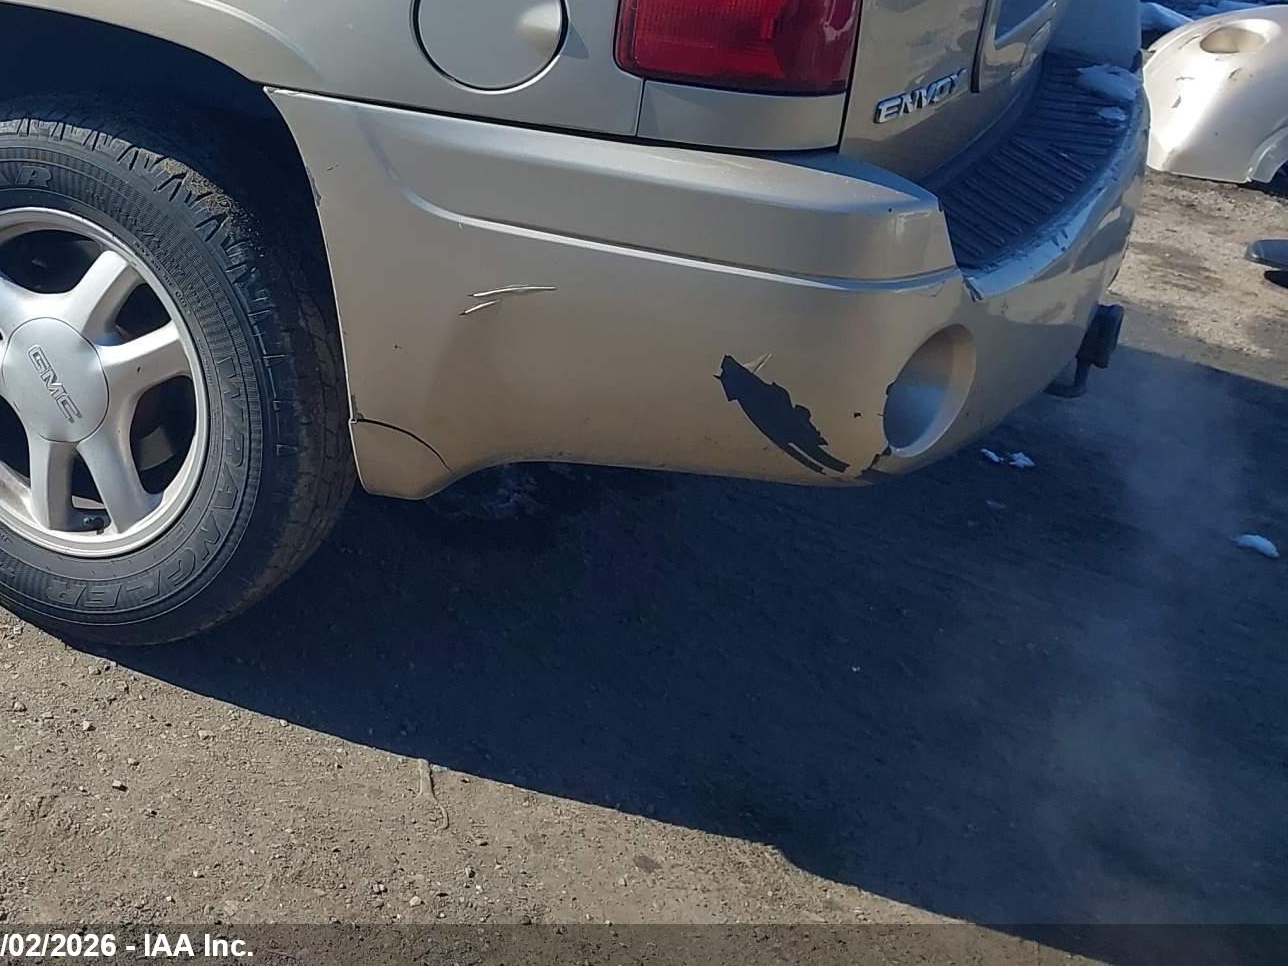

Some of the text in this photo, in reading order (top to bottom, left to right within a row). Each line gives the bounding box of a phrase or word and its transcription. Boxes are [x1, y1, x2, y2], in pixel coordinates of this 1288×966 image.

[874, 67, 968, 124] ENVOY
[27, 344, 83, 425] GMC
[44, 354, 249, 609] WRANGLER
